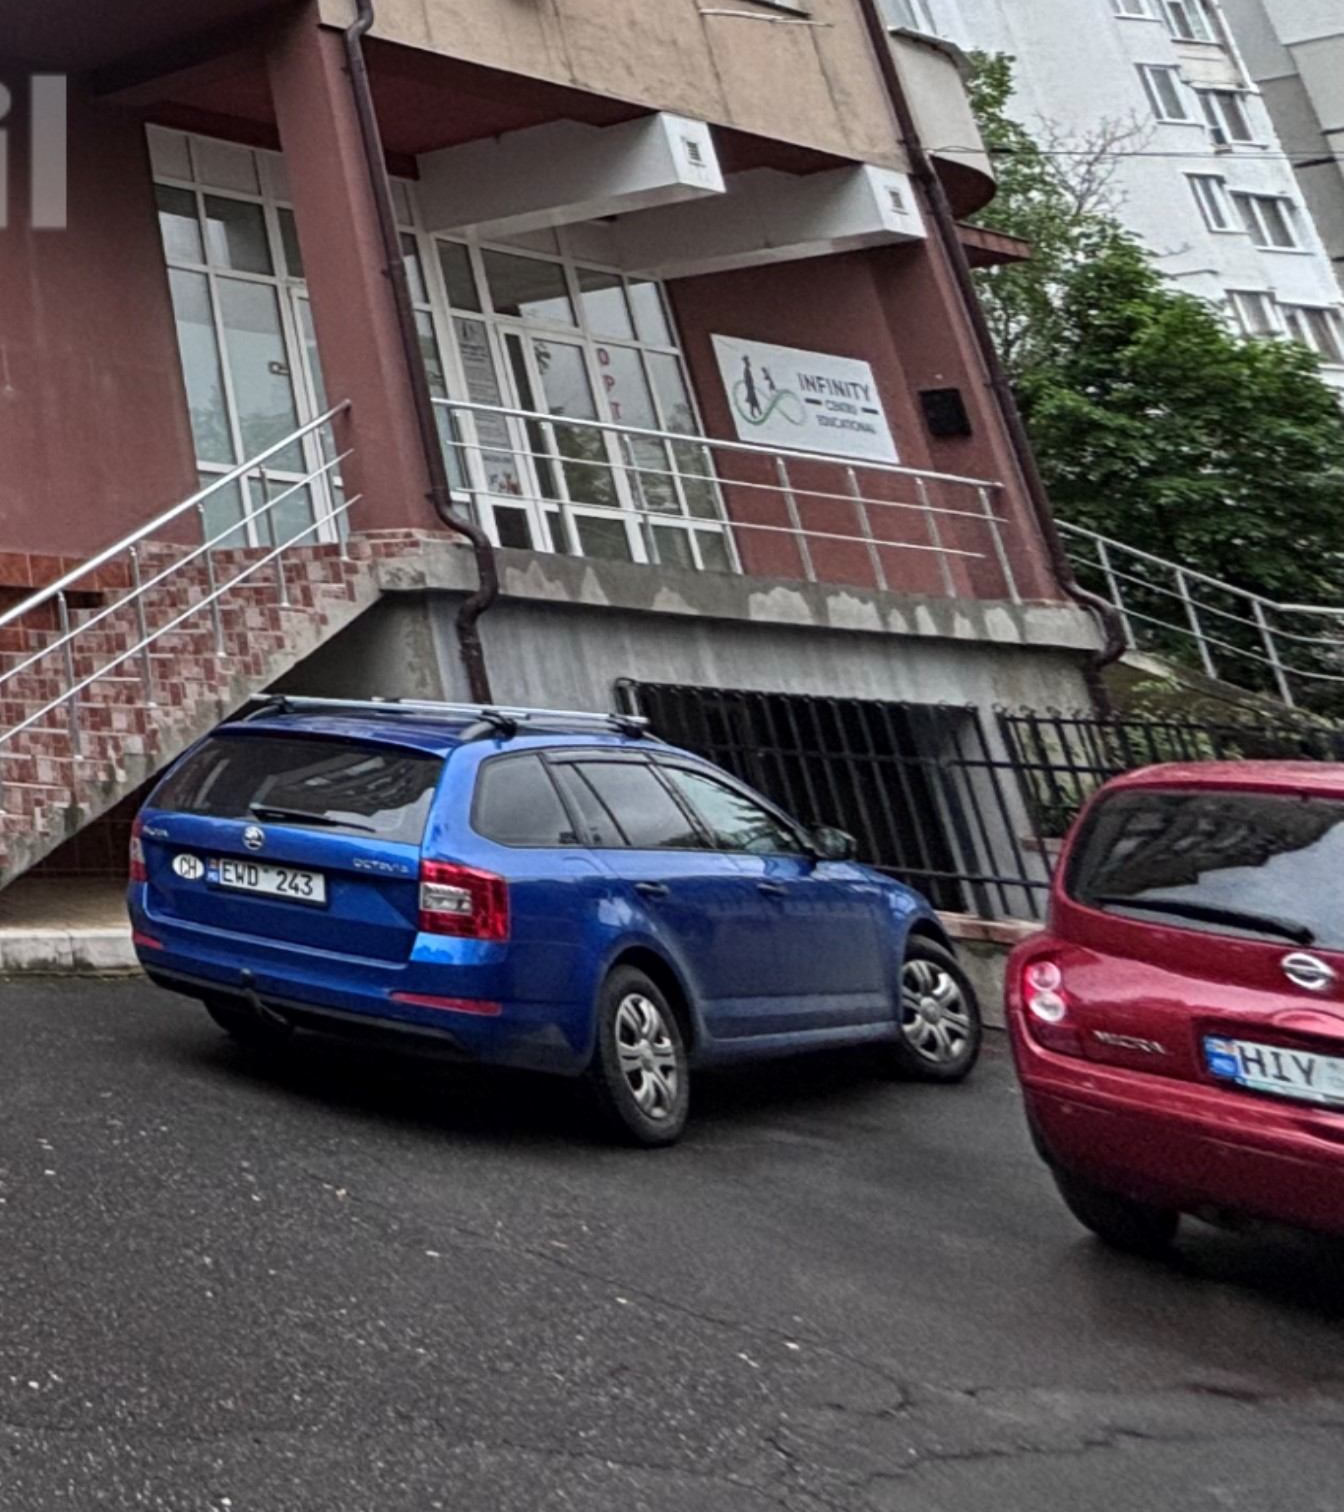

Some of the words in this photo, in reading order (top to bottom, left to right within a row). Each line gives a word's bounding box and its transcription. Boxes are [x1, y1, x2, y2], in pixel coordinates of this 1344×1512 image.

[796, 372, 871, 403] INFINITY
[221, 861, 259, 887] EWD
[275, 869, 314, 897] 243
[1237, 1045, 1316, 1087] HIY
